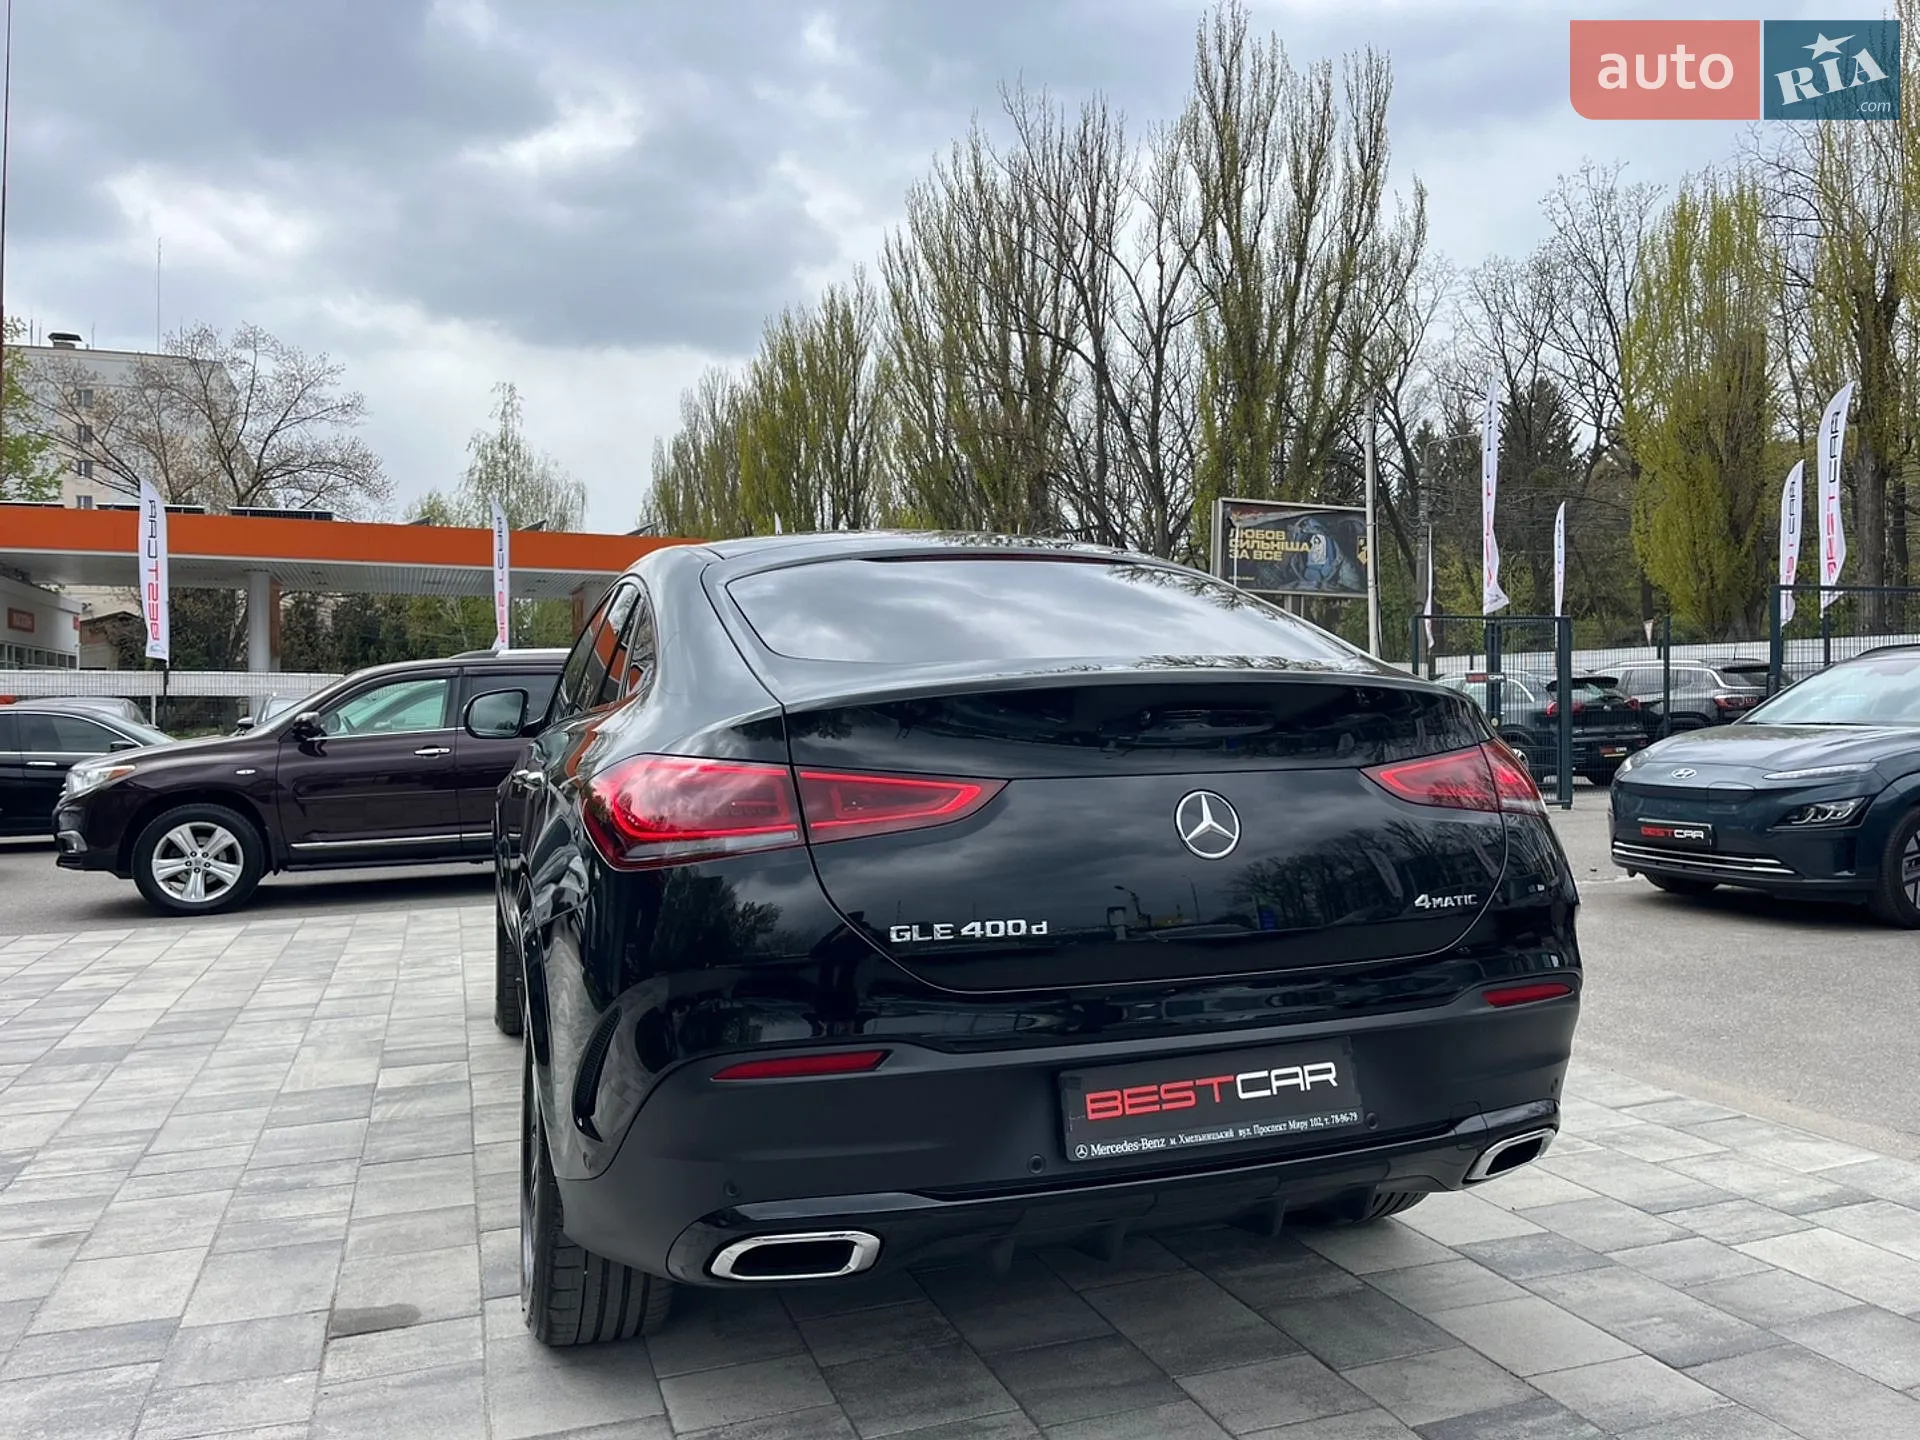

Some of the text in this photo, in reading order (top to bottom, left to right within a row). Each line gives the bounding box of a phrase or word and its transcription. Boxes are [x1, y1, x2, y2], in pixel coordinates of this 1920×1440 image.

[1229, 528, 1287, 541] ЛЮБОВ
[1229, 549, 1283, 561] ЗА ВСЕ
[1414, 893, 1478, 909] 4MATIC
[889, 923, 955, 943] GLE
[1090, 1137, 1167, 1156] Mercedes-Benz
[1253, 1122, 1287, 1136] Проспект
[1287, 1119, 1308, 1131] Миру
